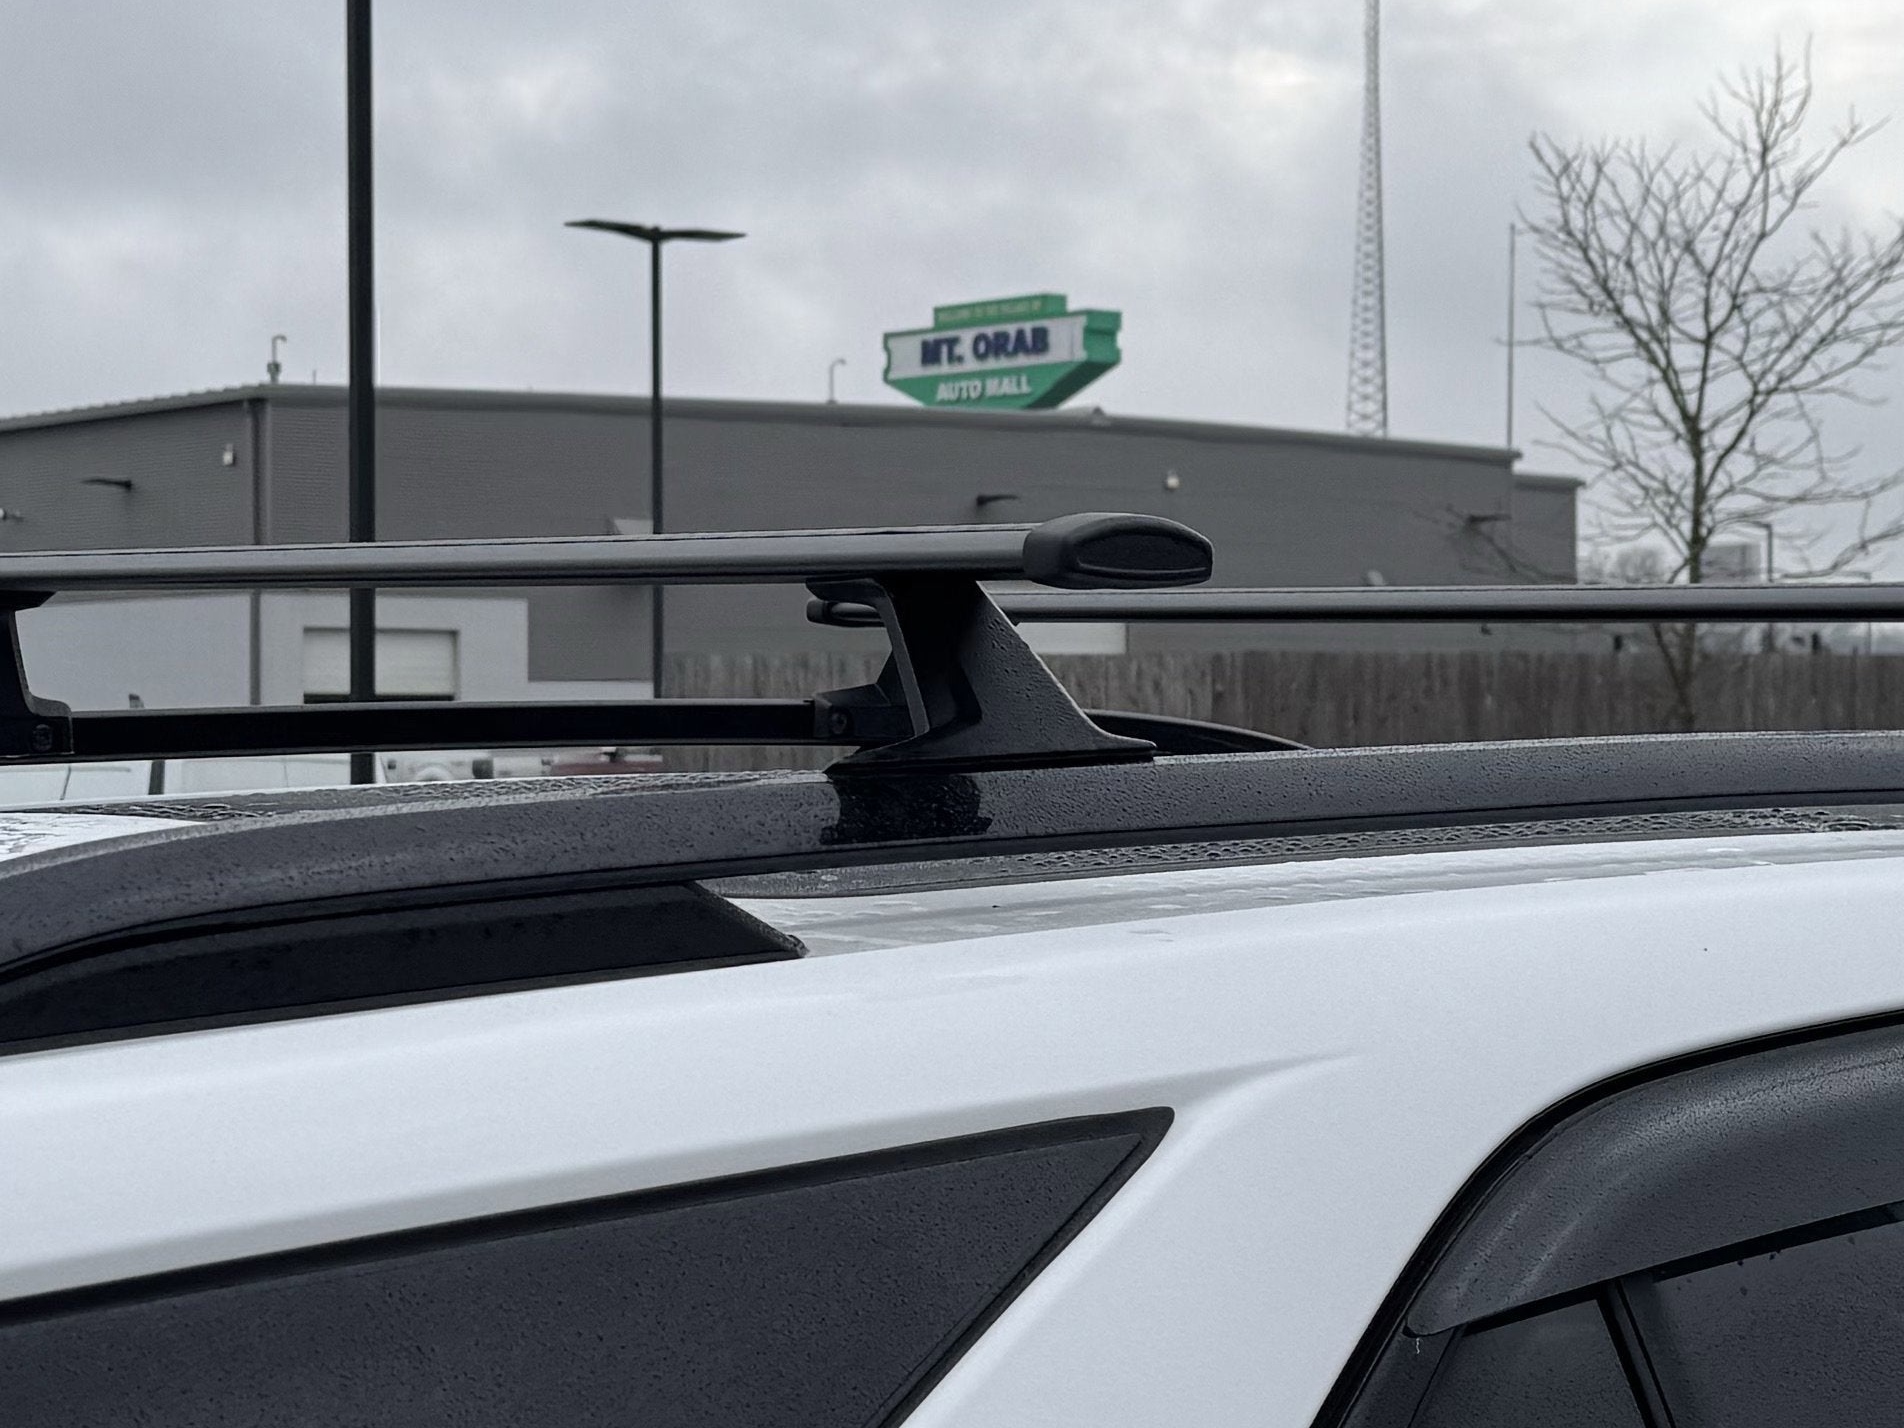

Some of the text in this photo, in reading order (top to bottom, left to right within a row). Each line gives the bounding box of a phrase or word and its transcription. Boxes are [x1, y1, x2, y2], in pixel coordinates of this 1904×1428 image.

[920, 326, 1049, 366] MT. ORAB
[936, 374, 1031, 401] AUTO MALL
